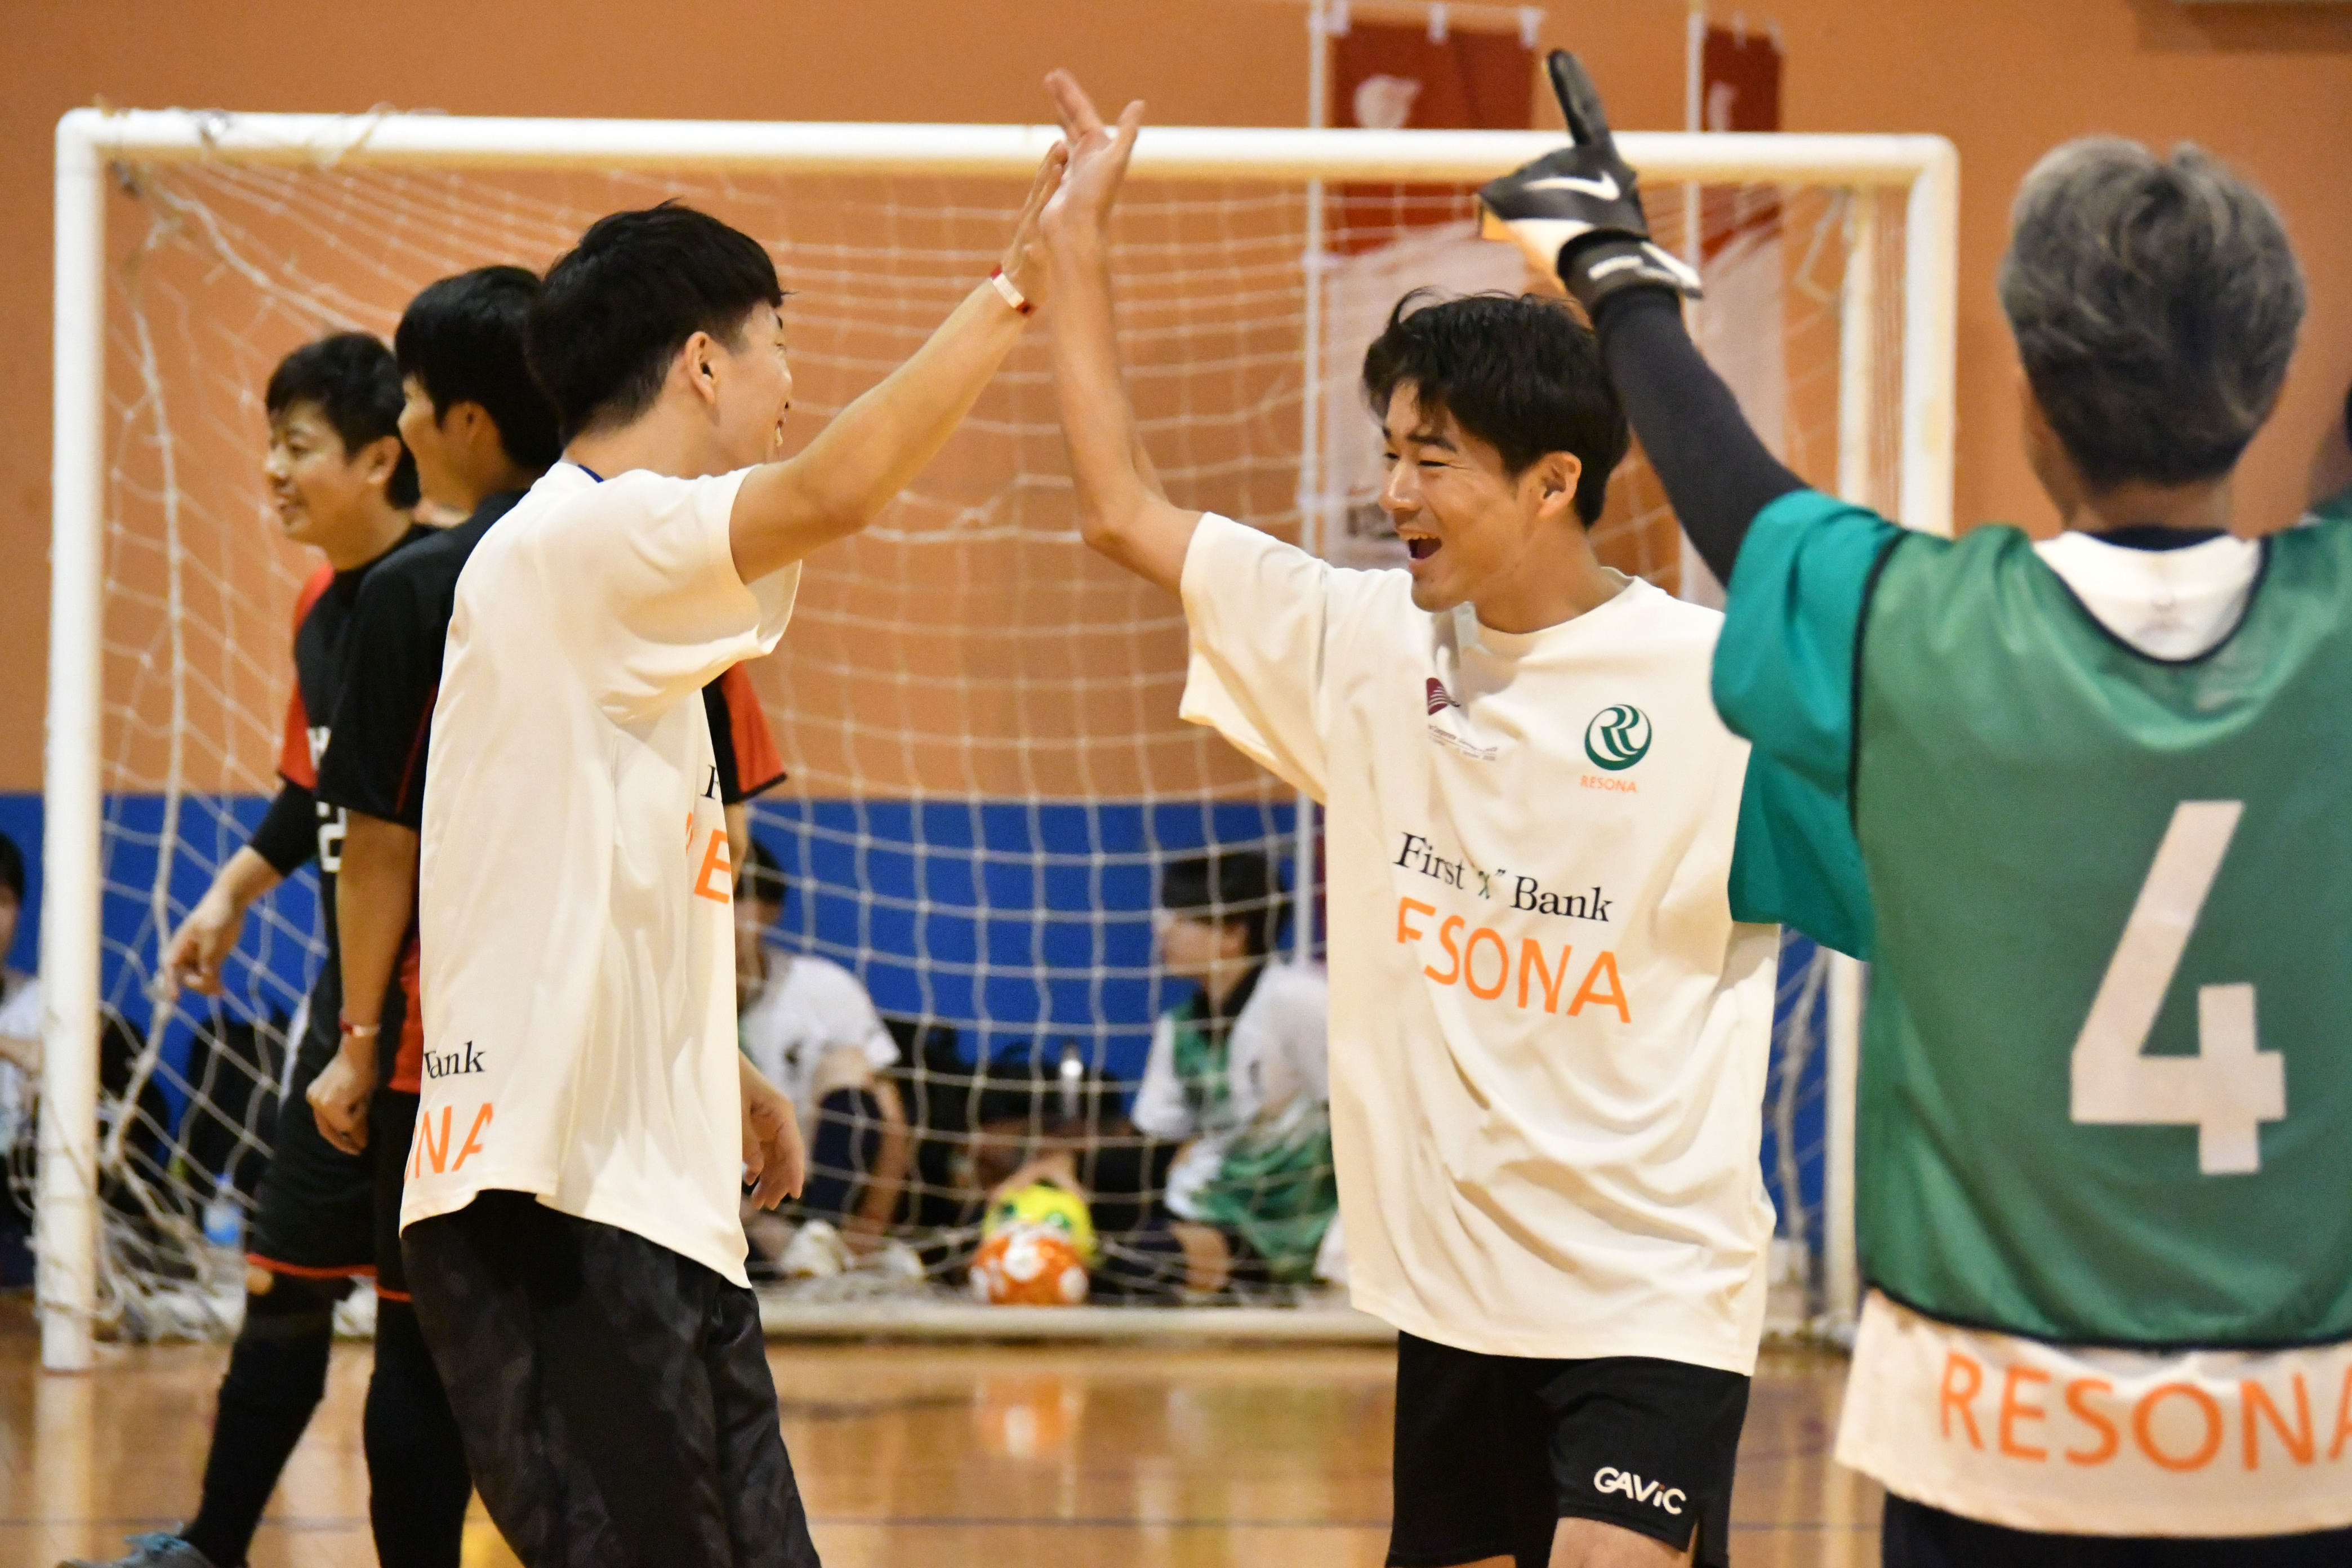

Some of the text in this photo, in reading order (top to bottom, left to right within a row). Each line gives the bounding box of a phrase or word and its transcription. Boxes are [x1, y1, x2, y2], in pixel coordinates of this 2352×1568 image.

[1580, 776, 1638, 793] RESONA
[1393, 832, 1465, 890] First
[1510, 875, 1613, 922] Bank
[2071, 800, 2287, 1175] 4
